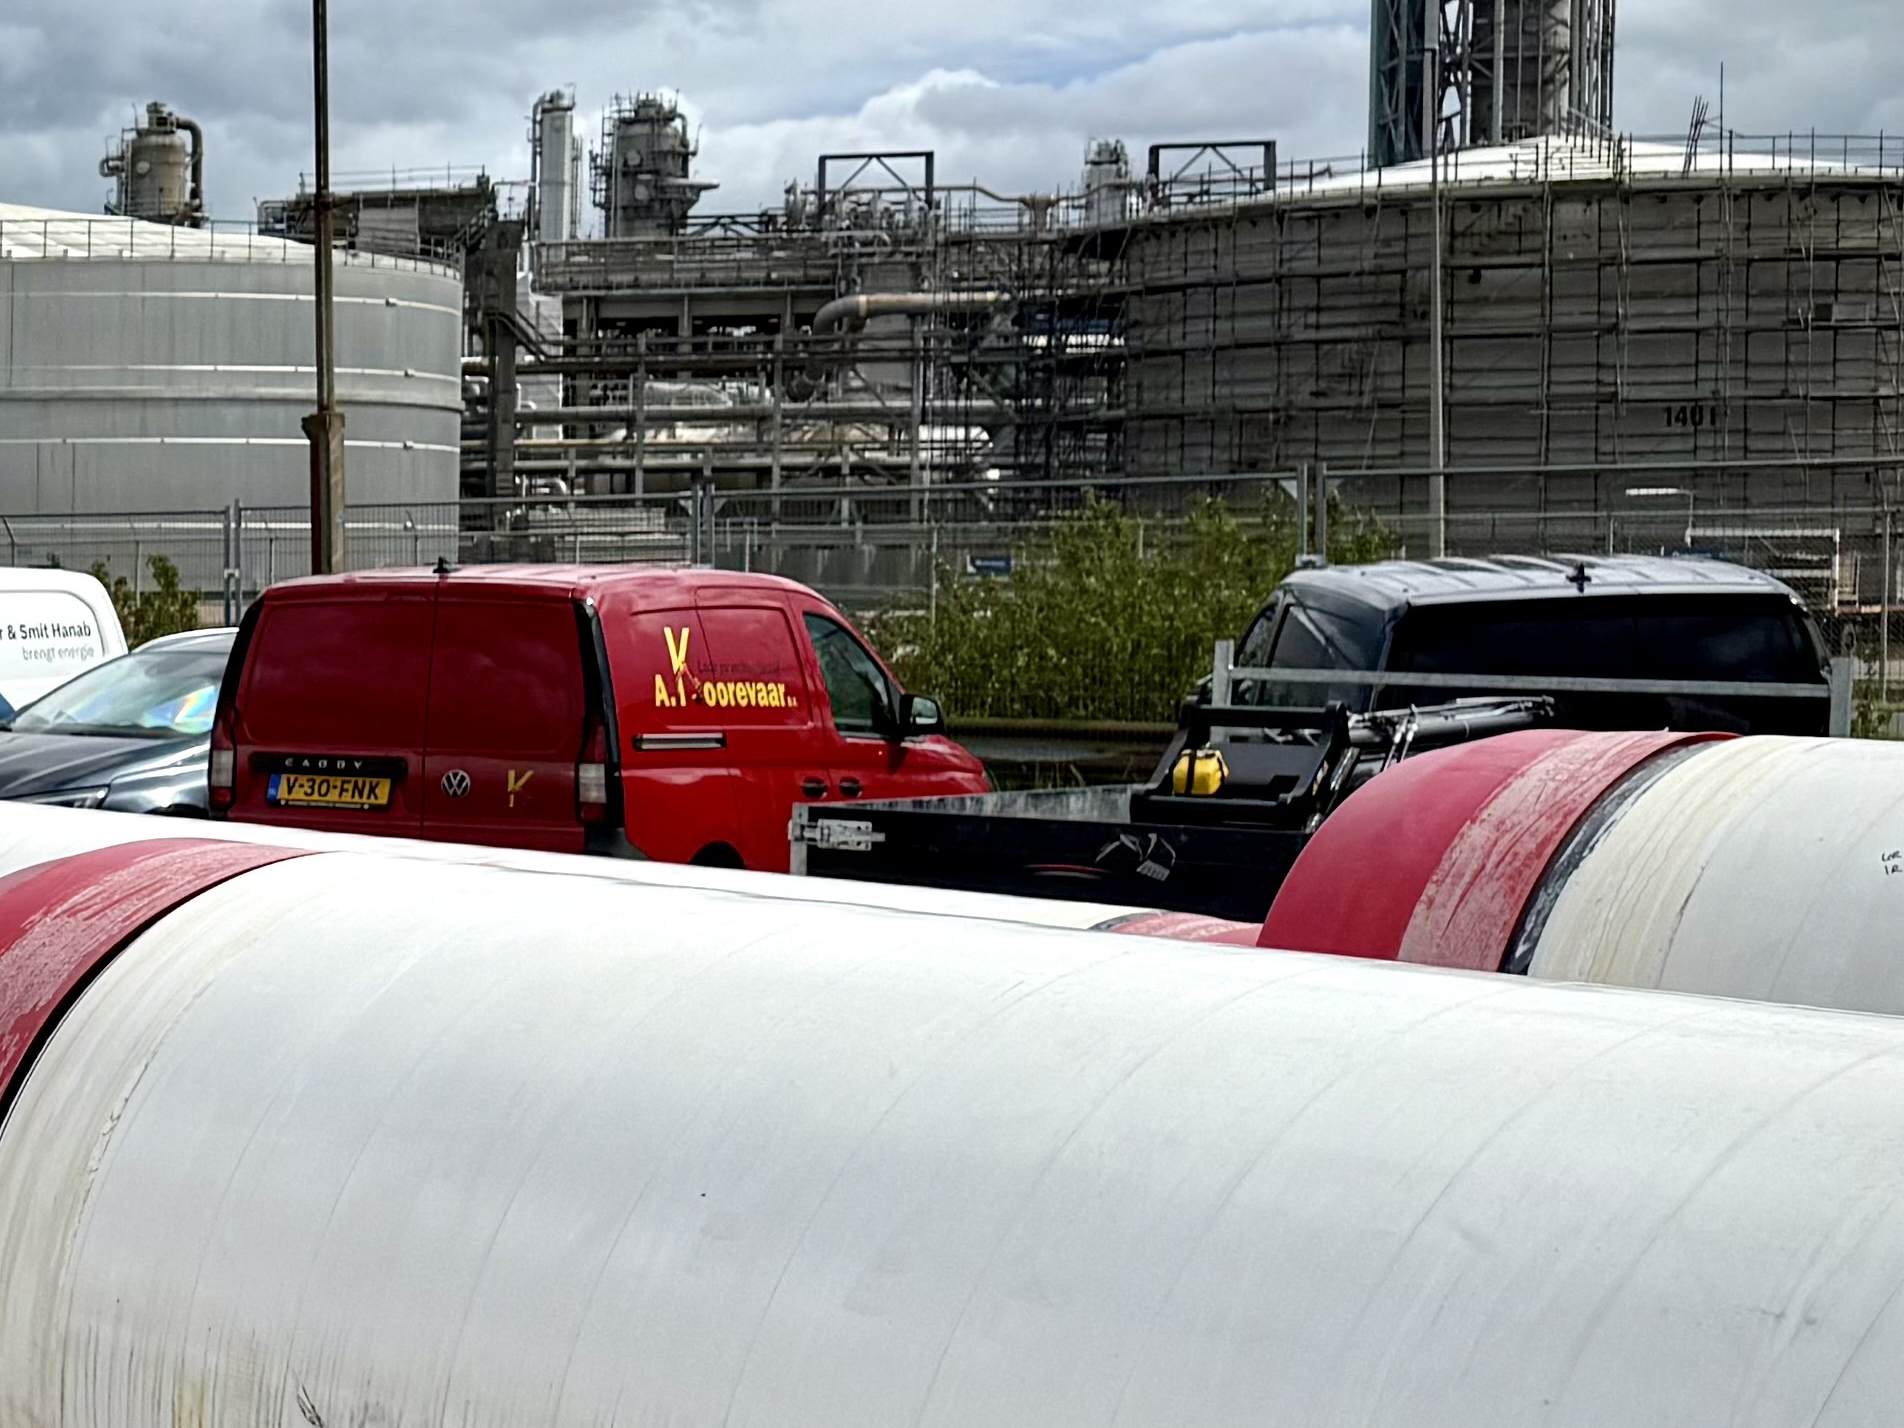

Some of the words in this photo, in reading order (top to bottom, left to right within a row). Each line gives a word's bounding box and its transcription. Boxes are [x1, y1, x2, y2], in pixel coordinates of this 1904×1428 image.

[1666, 405, 1716, 427] 1401
[7, 624, 17, 640] &
[19, 623, 49, 640] Smit
[52, 621, 92, 639] Hanab
[22, 646, 56, 663] brengt
[58, 644, 95, 662] energie
[284, 757, 363, 770] CADDY
[286, 776, 381, 801] V-30-FNK
